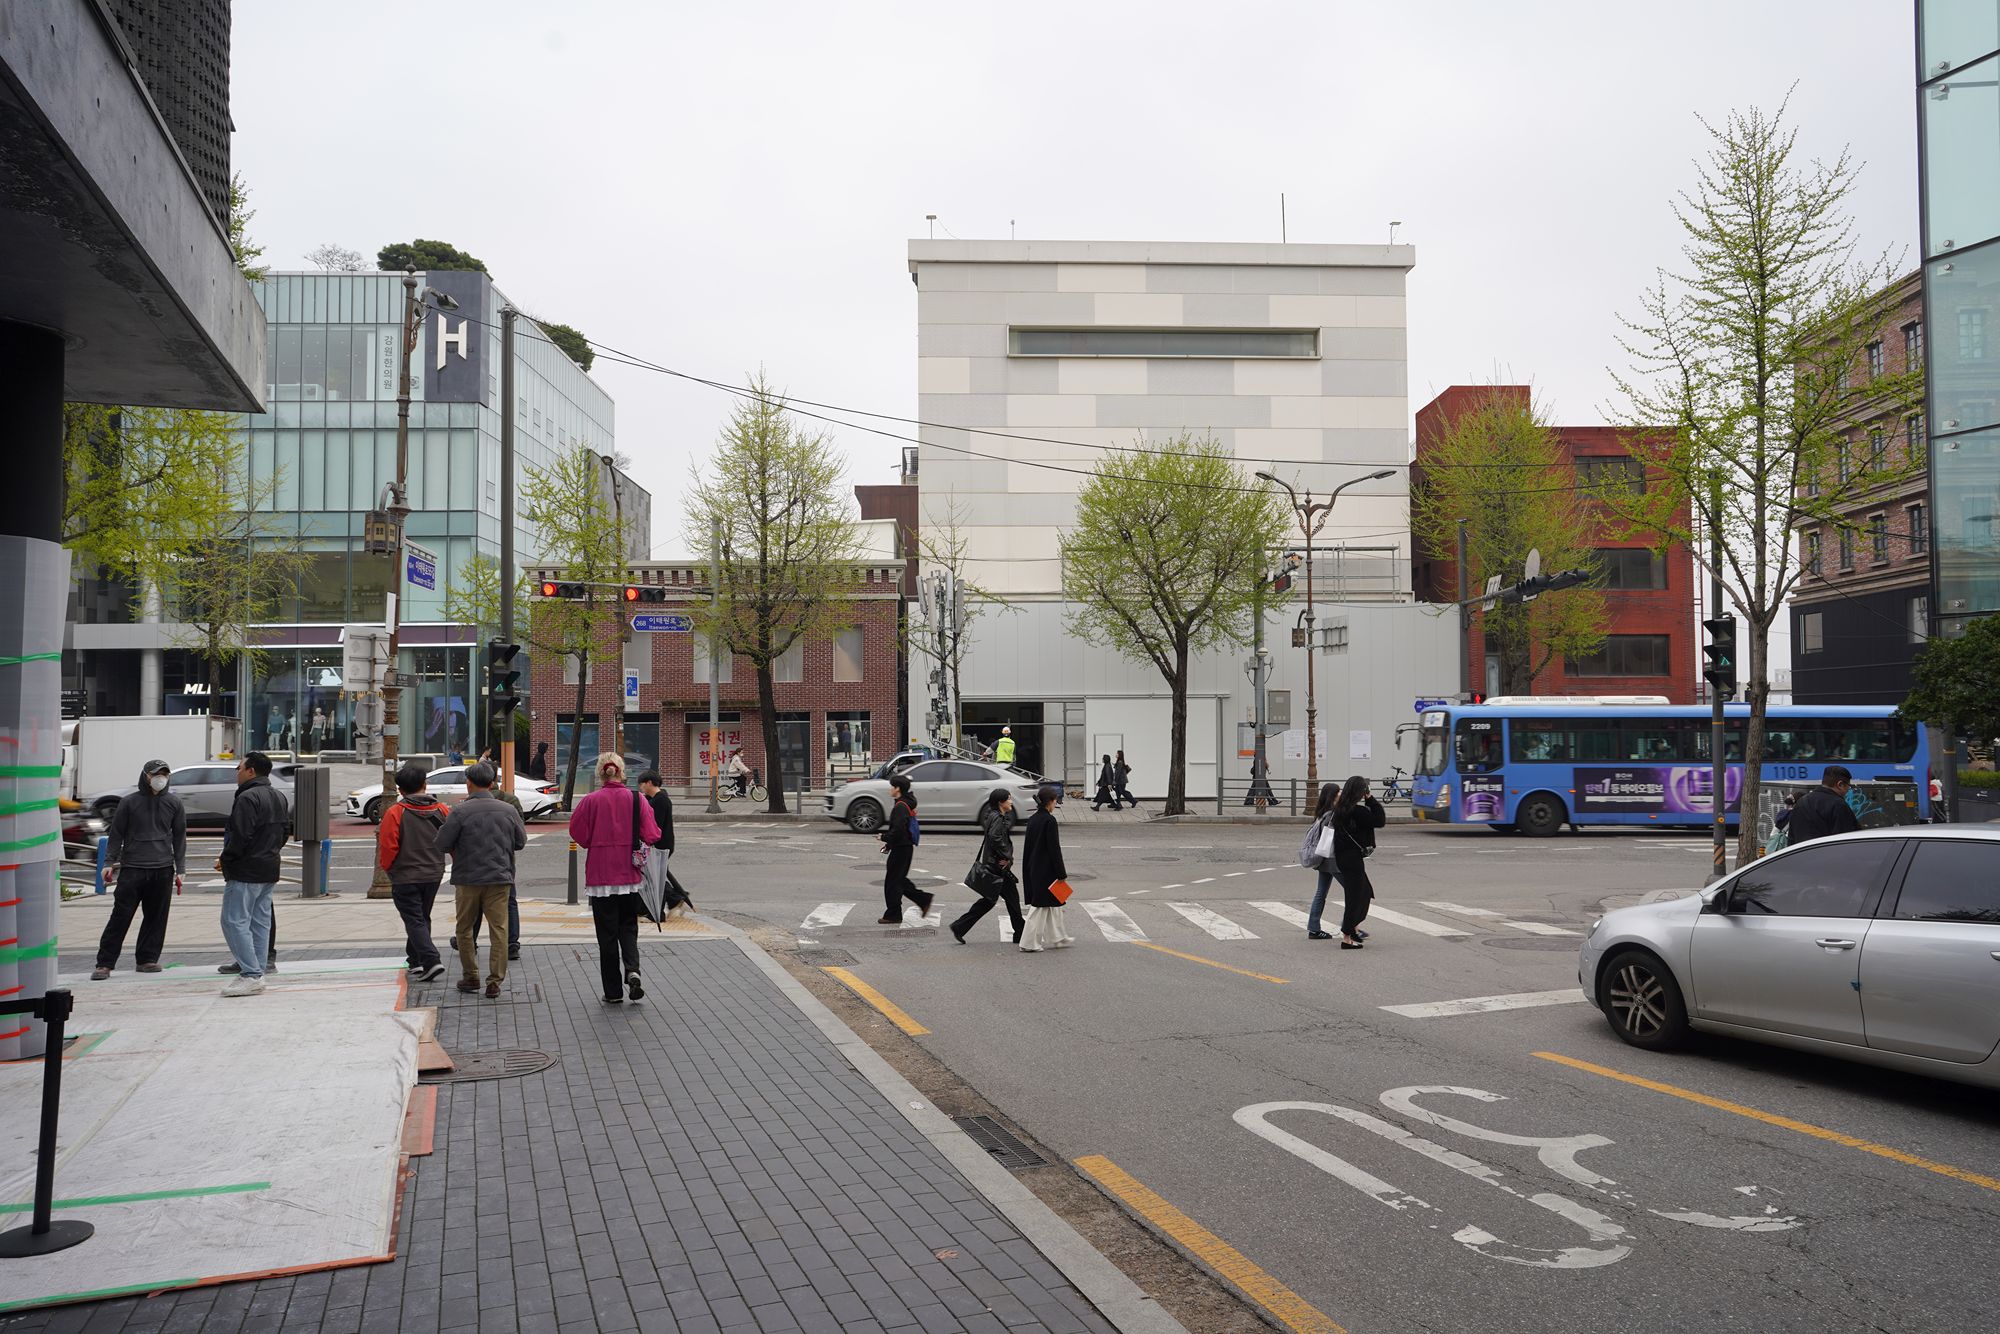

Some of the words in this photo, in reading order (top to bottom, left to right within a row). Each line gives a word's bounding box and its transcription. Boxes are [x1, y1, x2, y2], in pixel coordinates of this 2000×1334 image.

[437, 313, 467, 371] H
[383, 335, 393, 390] 강원한의원
[648, 616, 676, 624] 이태원로
[1773, 766, 1808, 779] 110B
